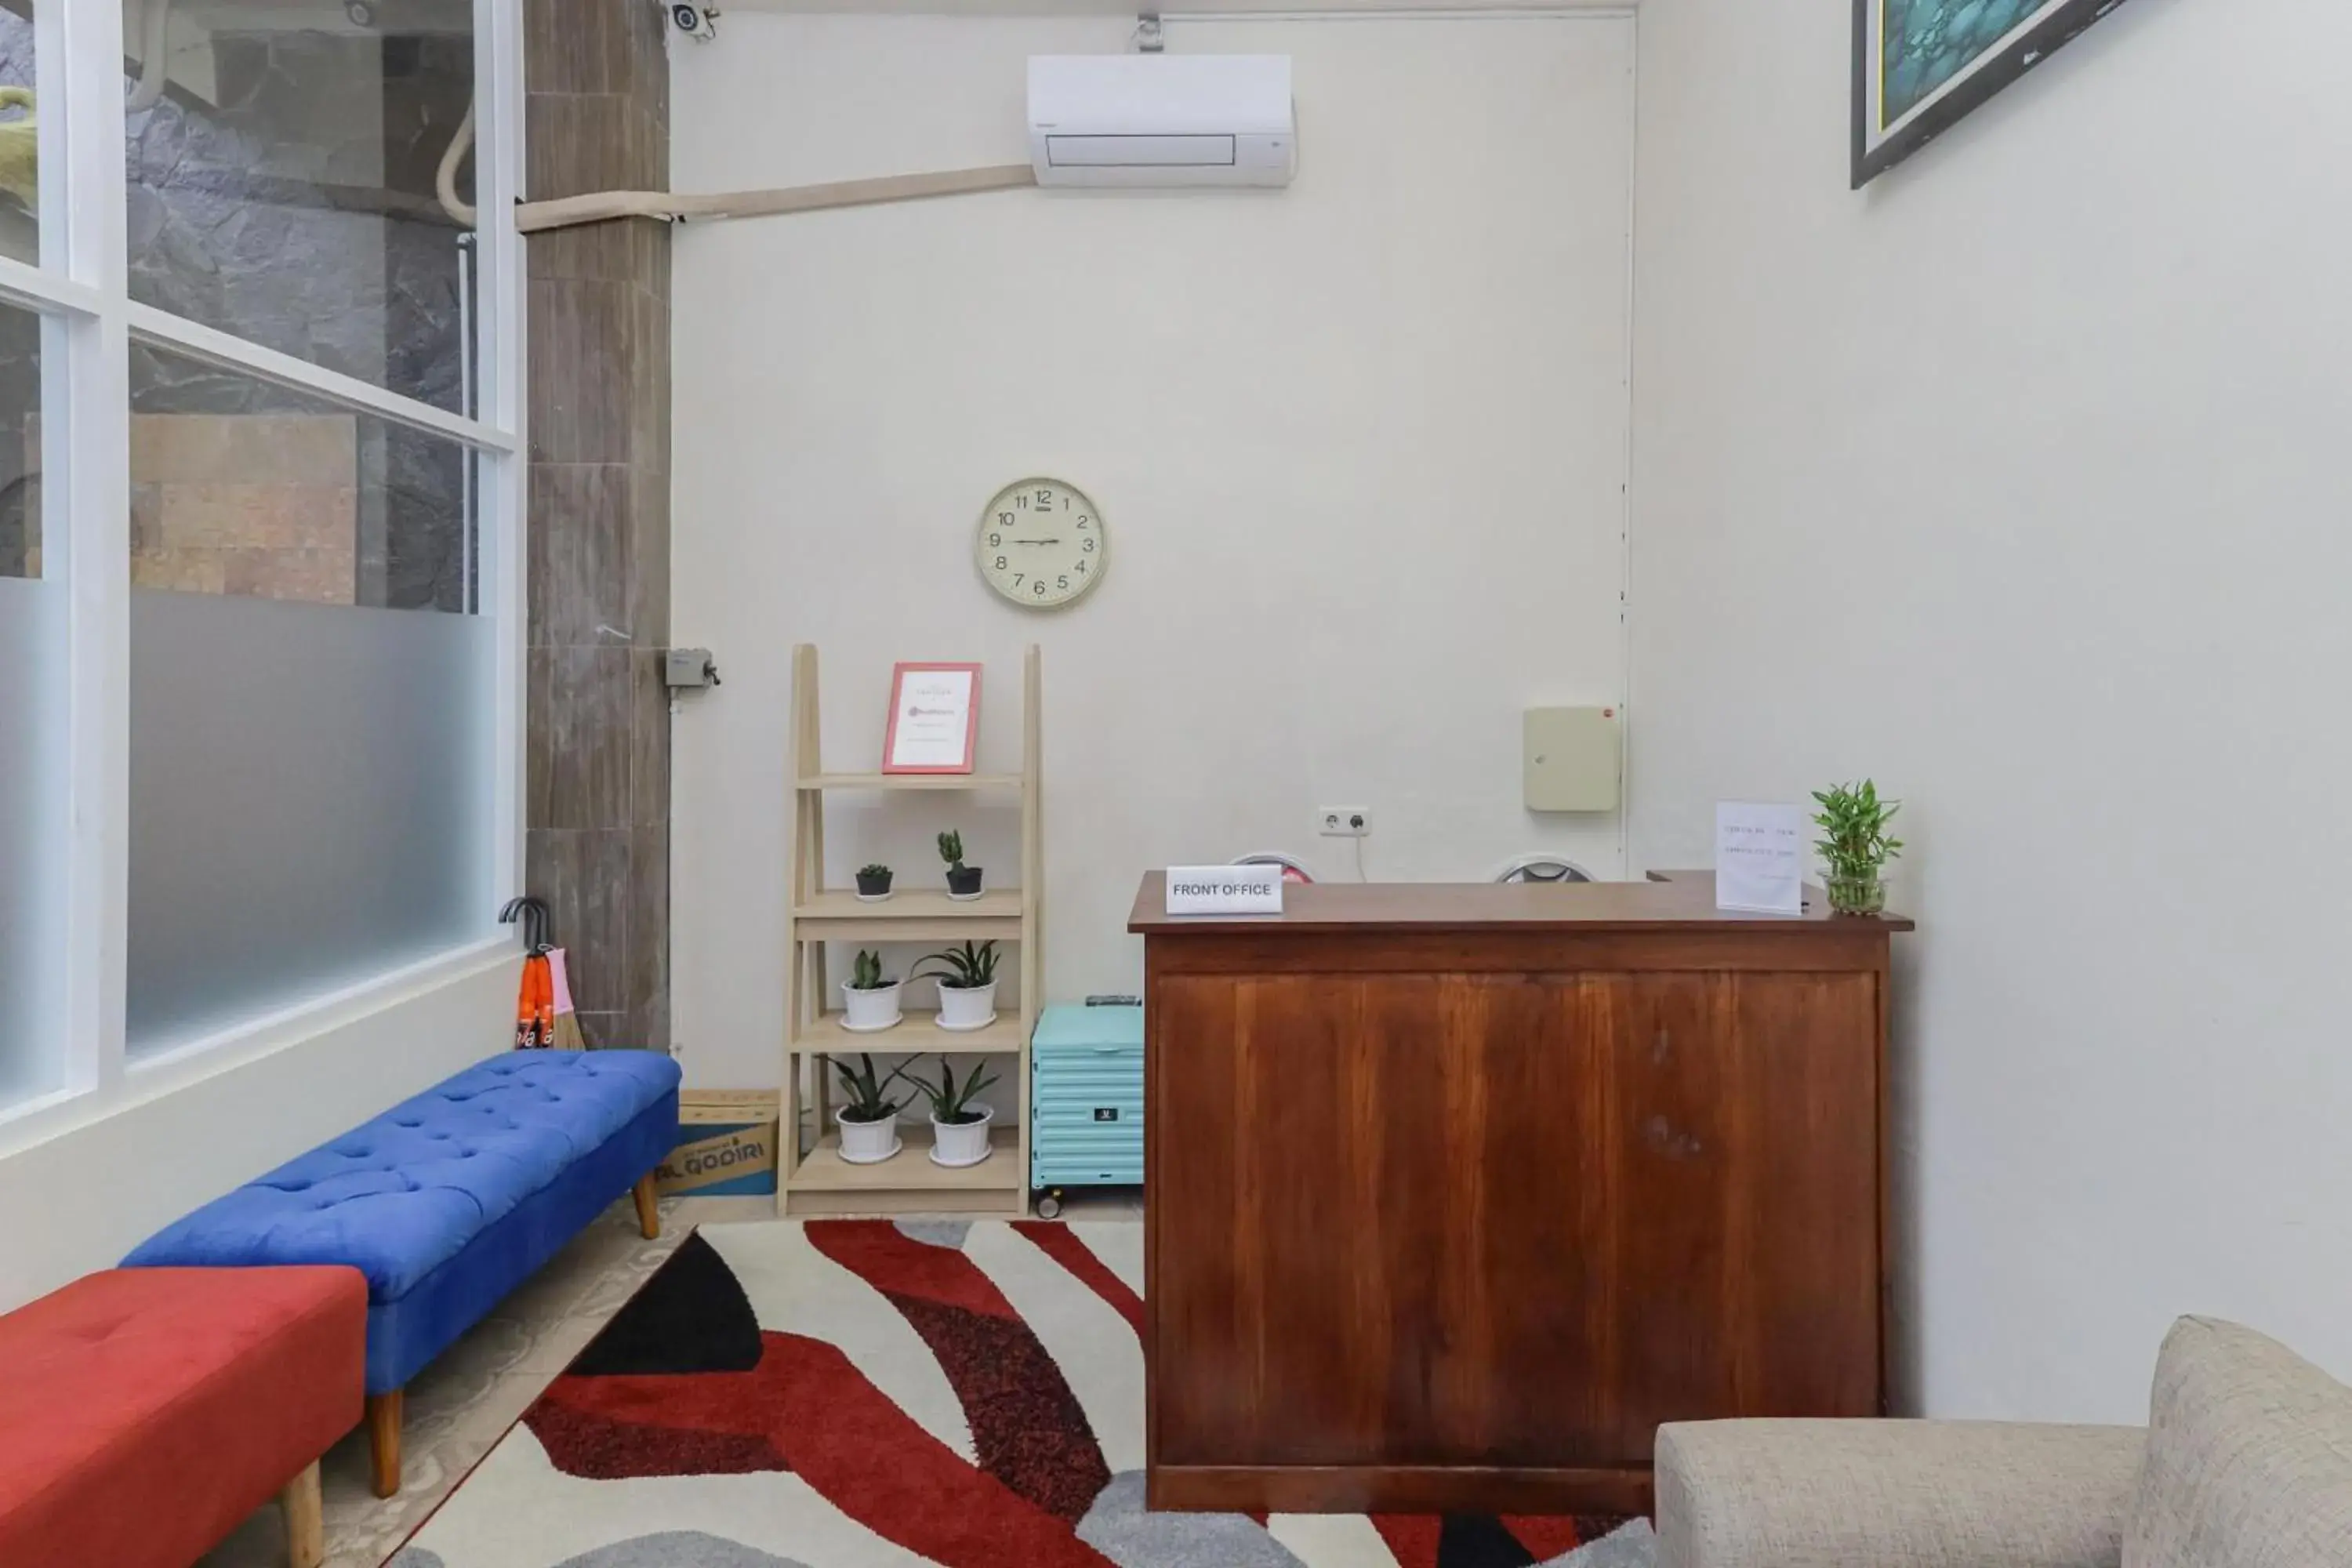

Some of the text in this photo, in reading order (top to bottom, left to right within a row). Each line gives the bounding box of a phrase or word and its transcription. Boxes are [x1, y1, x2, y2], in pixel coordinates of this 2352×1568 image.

[1015, 495, 1027, 509] 11
[1036, 490, 1051, 504] 12
[1063, 498, 1069, 510] 1
[998, 512, 1014, 526] 10
[1076, 515, 1087, 529] 2
[989, 533, 1001, 547] 9
[1083, 538, 1094, 553] 3
[996, 556, 1007, 570] 8
[1074, 559, 1085, 573] 4
[1014, 573, 1025, 586] 7
[1057, 575, 1068, 589] 5
[1034, 581, 1045, 595] 6
[1174, 884, 1272, 896] FRONT OFFICE
